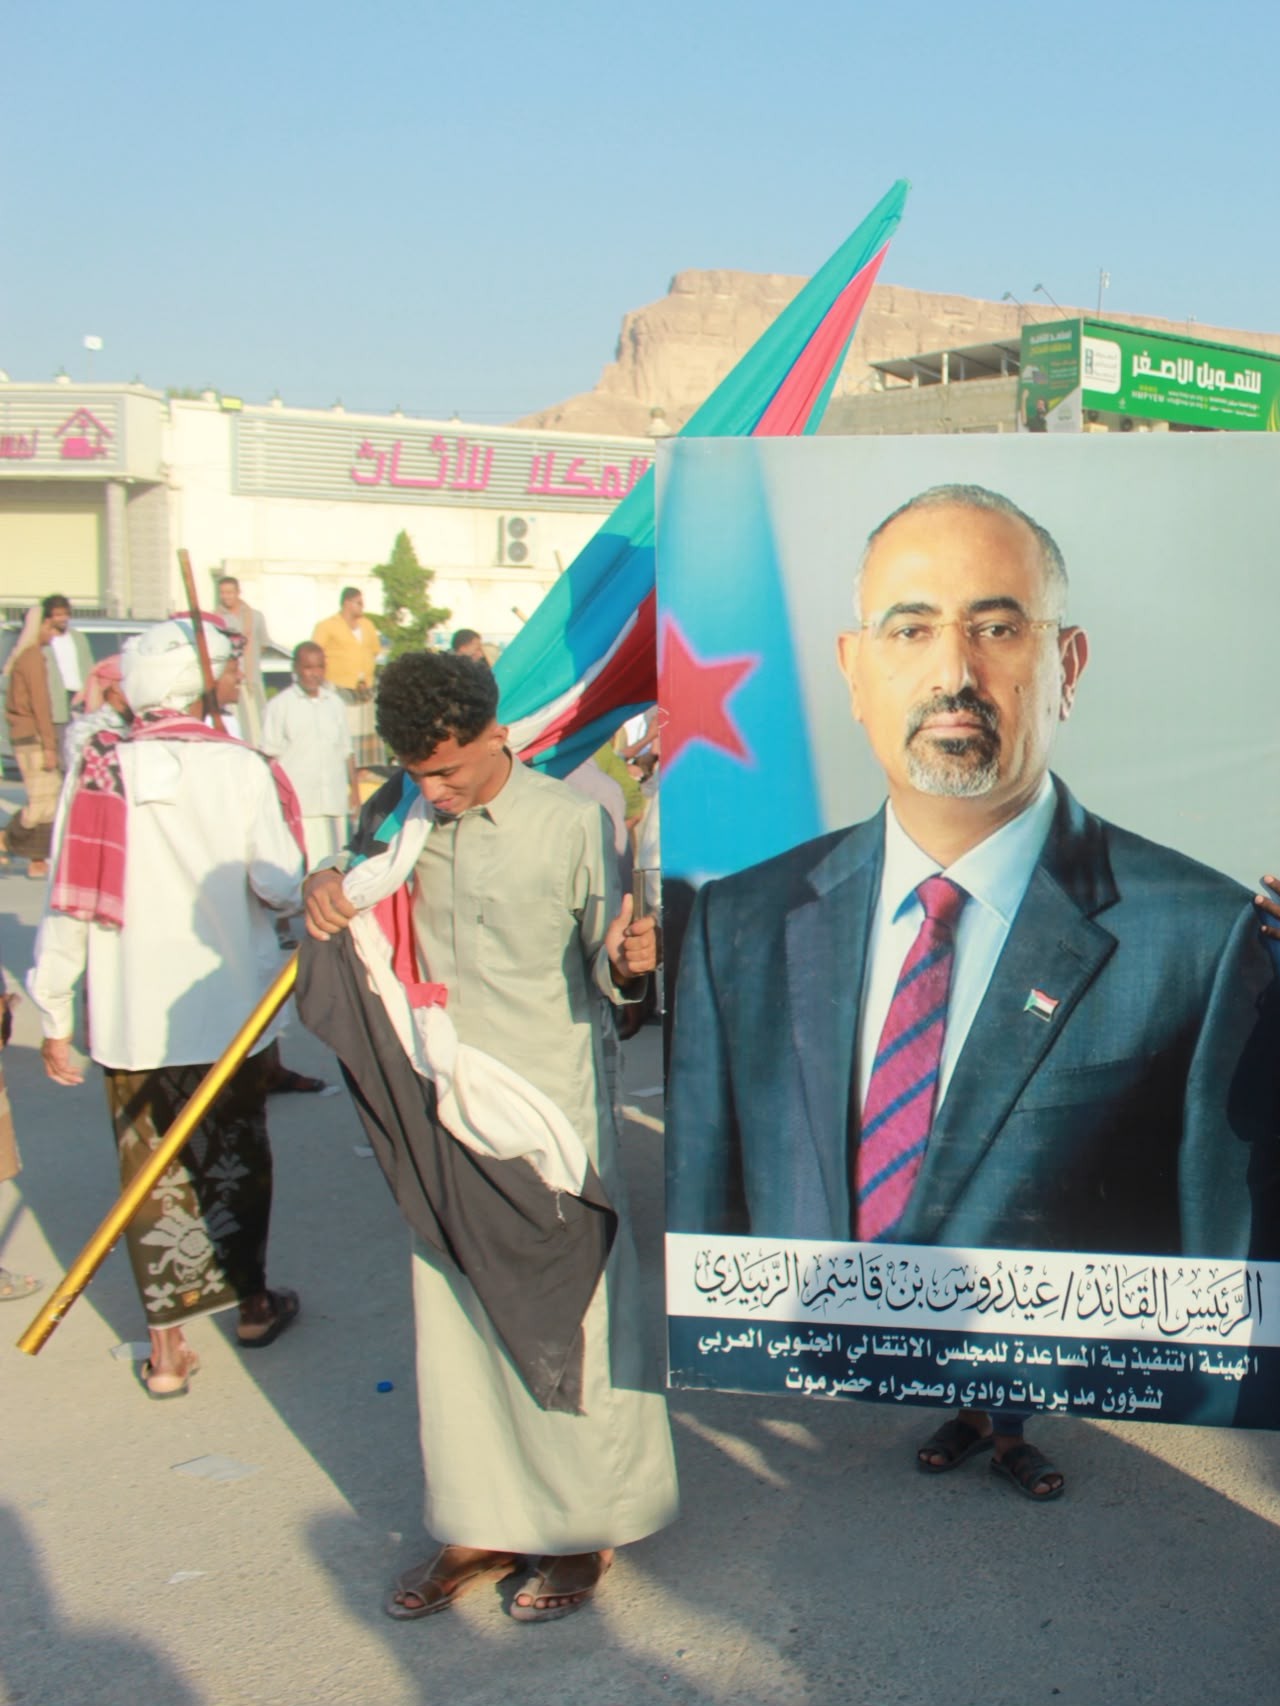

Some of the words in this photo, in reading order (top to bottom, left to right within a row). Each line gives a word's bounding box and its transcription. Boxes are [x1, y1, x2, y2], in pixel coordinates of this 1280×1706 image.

[1196, 361, 1262, 395] للتمويل
[697, 1327, 763, 1355] العربي
[767, 1329, 841, 1359] الجنوبي
[846, 1332, 932, 1364] الانتقالي
[935, 1337, 1009, 1368] للمجلس
[1014, 1340, 1096, 1369] المساعدة
[1101, 1345, 1194, 1376] التنفيذية
[1199, 1350, 1259, 1382] الهيئة
[785, 1366, 873, 1396] حضرموت
[878, 1374, 956, 1402] وصحراء
[960, 1379, 1005, 1408] وادي
[1009, 1379, 1096, 1411] مديريات
[1101, 1384, 1164, 1414] لشؤون
